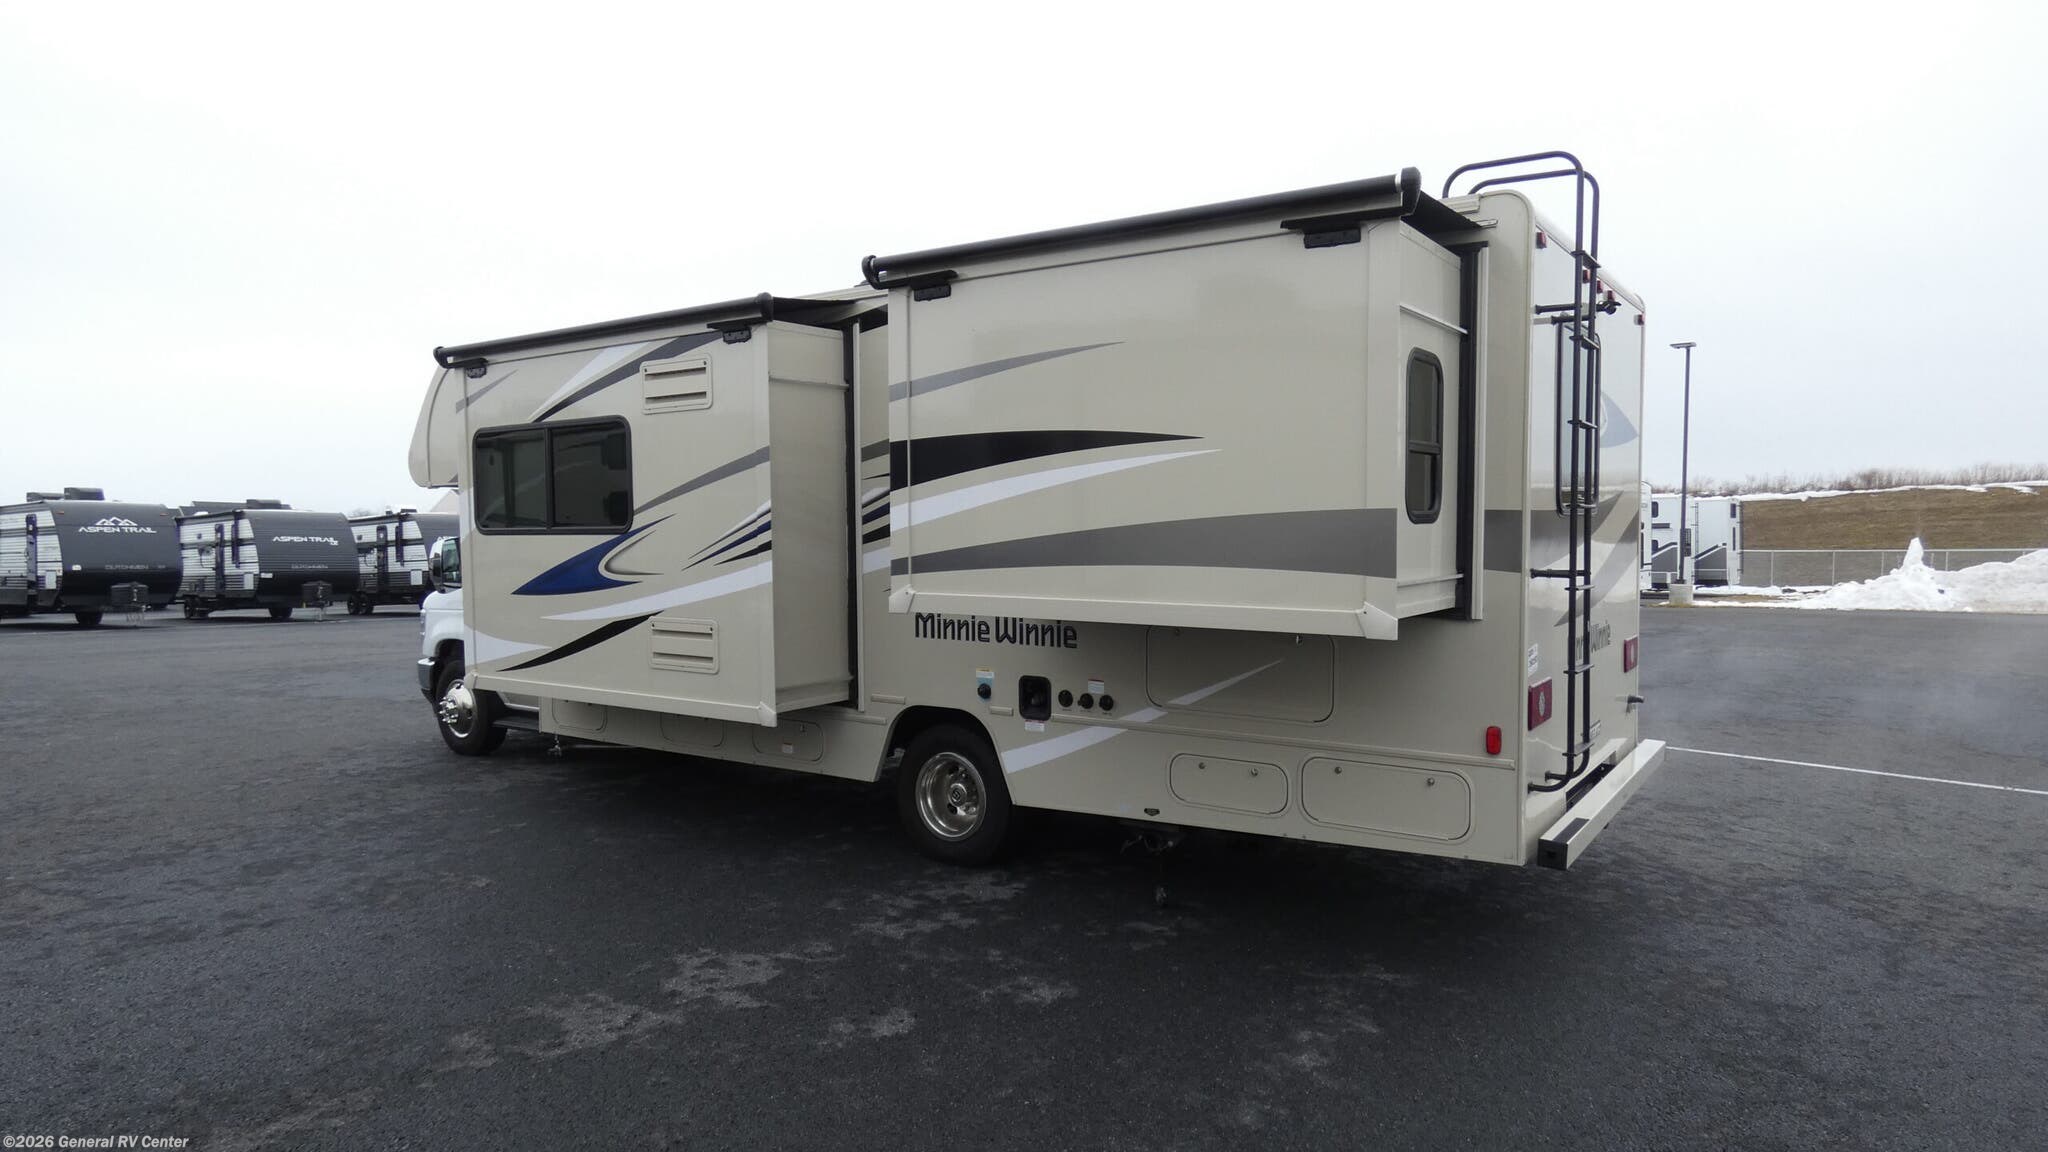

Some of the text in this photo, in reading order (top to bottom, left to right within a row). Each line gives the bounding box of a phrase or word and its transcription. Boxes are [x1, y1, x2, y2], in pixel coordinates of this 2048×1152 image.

[121, 526, 157, 534] TRAIL
[914, 612, 1078, 649] Minnie Winnie
